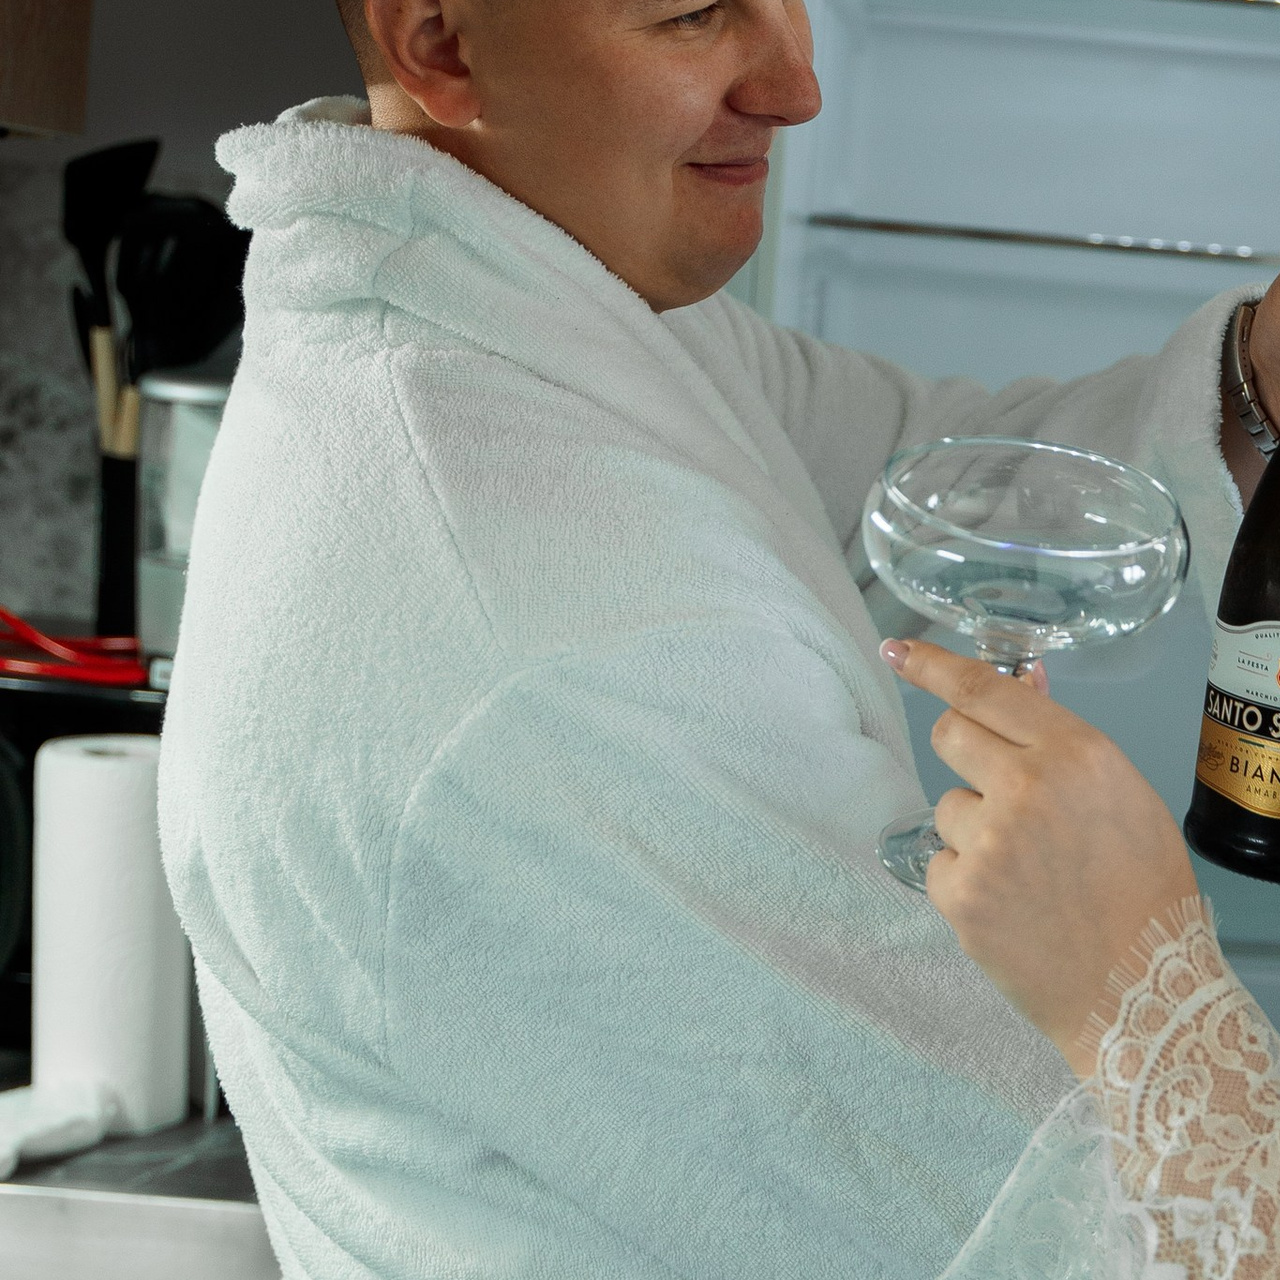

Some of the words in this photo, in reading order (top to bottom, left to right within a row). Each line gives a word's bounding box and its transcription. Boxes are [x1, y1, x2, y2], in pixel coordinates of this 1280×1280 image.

[1237, 657, 1246, 665] LA
[1247, 660, 1269, 671] FESTA
[1245, 689, 1278, 702] MARCHIO
[1207, 690, 1262, 731] SANTO
